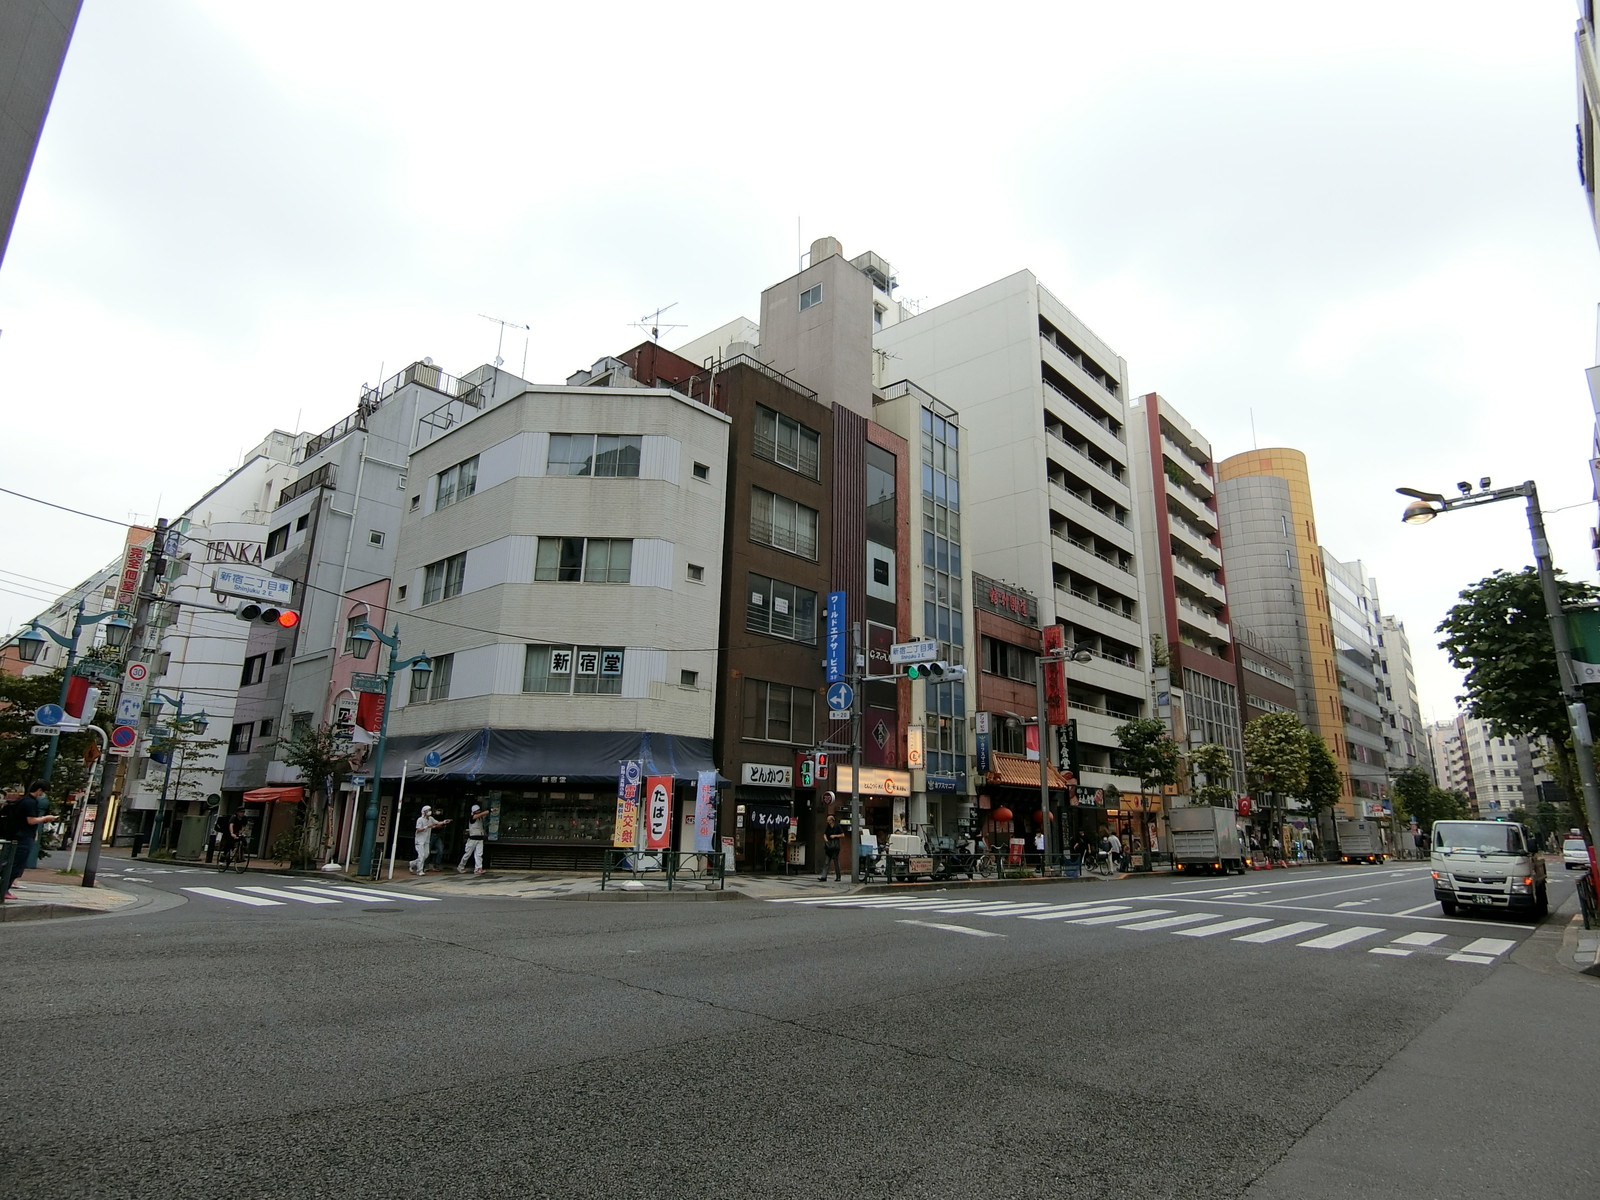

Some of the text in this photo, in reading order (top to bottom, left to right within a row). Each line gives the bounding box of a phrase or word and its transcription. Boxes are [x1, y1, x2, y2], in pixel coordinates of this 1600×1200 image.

[207, 542, 262, 563] TENKA
[220, 571, 289, 593] 新宿二丁目東
[234, 584, 260, 595] Shinjuku
[830, 595, 838, 674] ワールドエアサービス
[893, 644, 933, 655] 新宿二丁目東
[552, 652, 620, 673] 新宿堂
[132, 668, 142, 677] 30
[751, 766, 784, 783] とんかつ
[652, 790, 665, 835] たばこ
[759, 813, 790, 824] とんかつ
